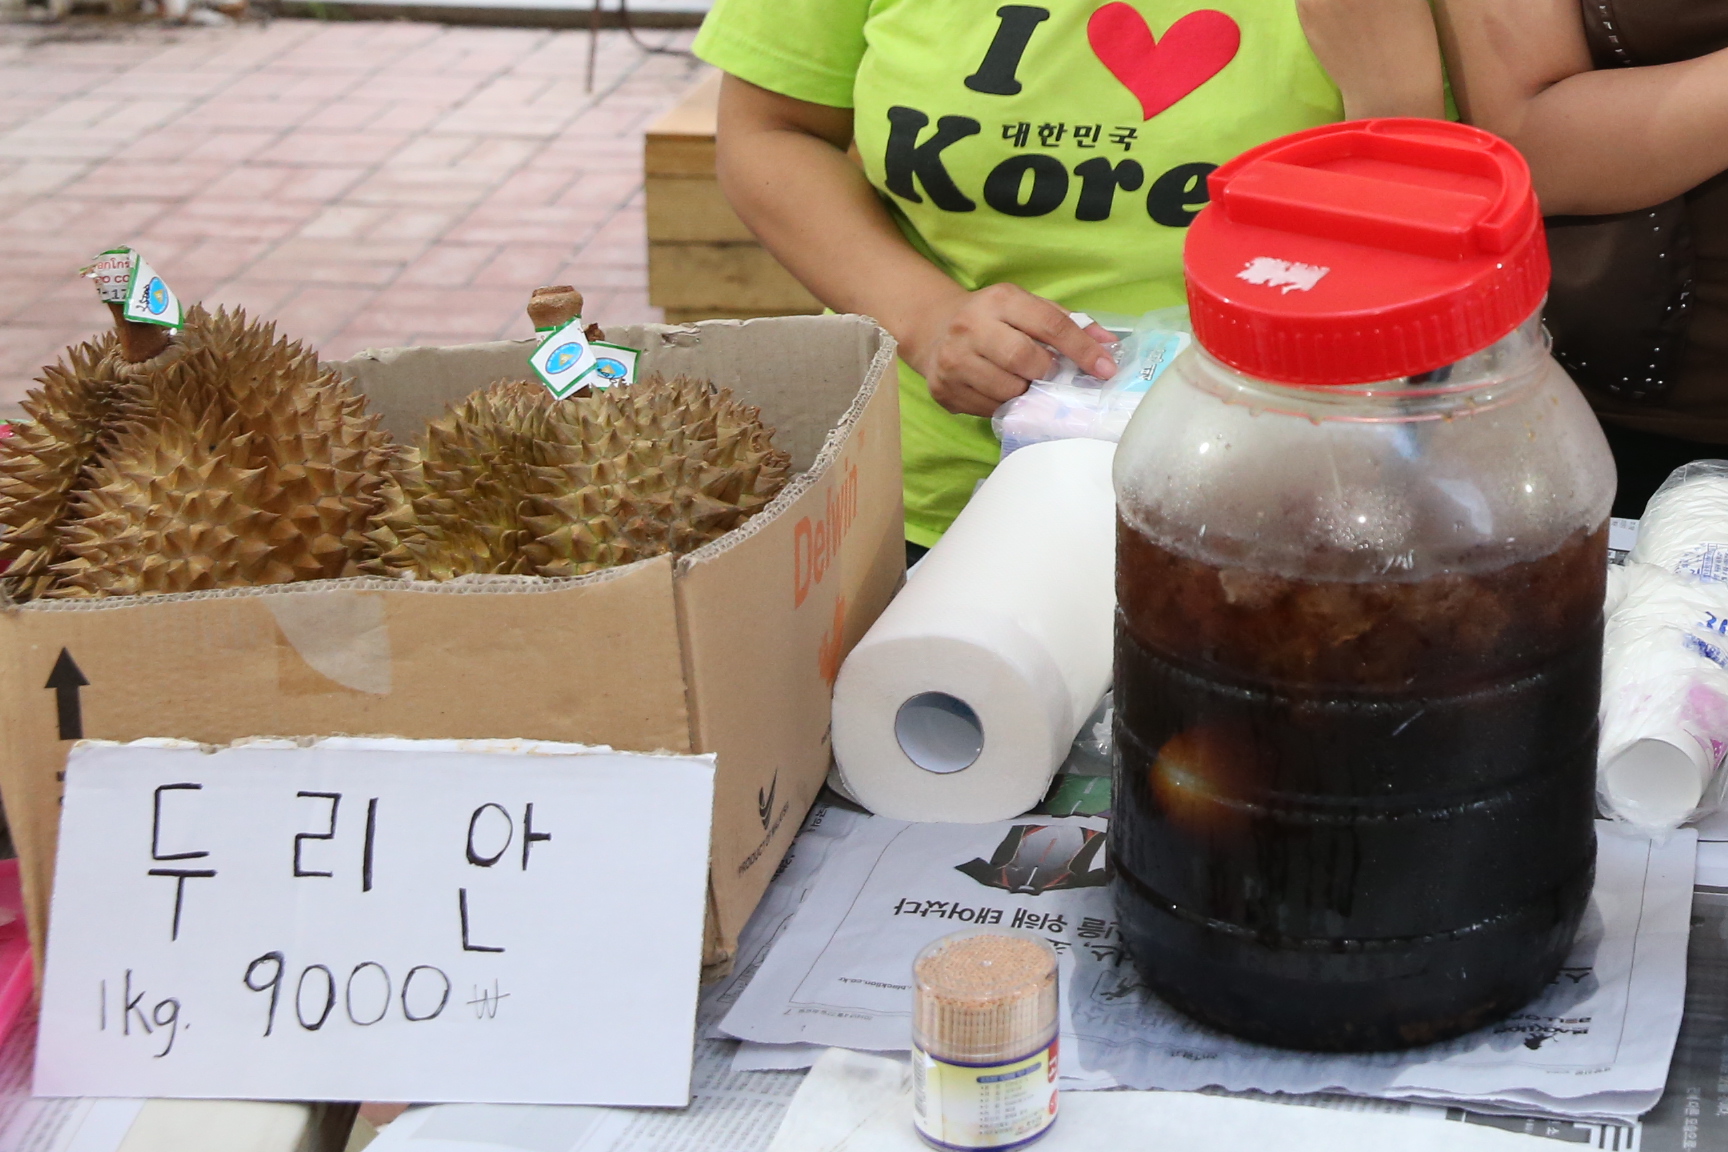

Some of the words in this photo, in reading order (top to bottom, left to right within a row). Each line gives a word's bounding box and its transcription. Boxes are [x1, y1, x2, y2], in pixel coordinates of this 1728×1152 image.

[963, 4, 1050, 96] I
[884, 105, 1222, 227] Kore
[1001, 122, 1138, 150] 대한민국
[147, 782, 552, 953] 두리안
[893, 897, 1004, 925] 태어났다
[1010, 907, 1068, 933] 위해
